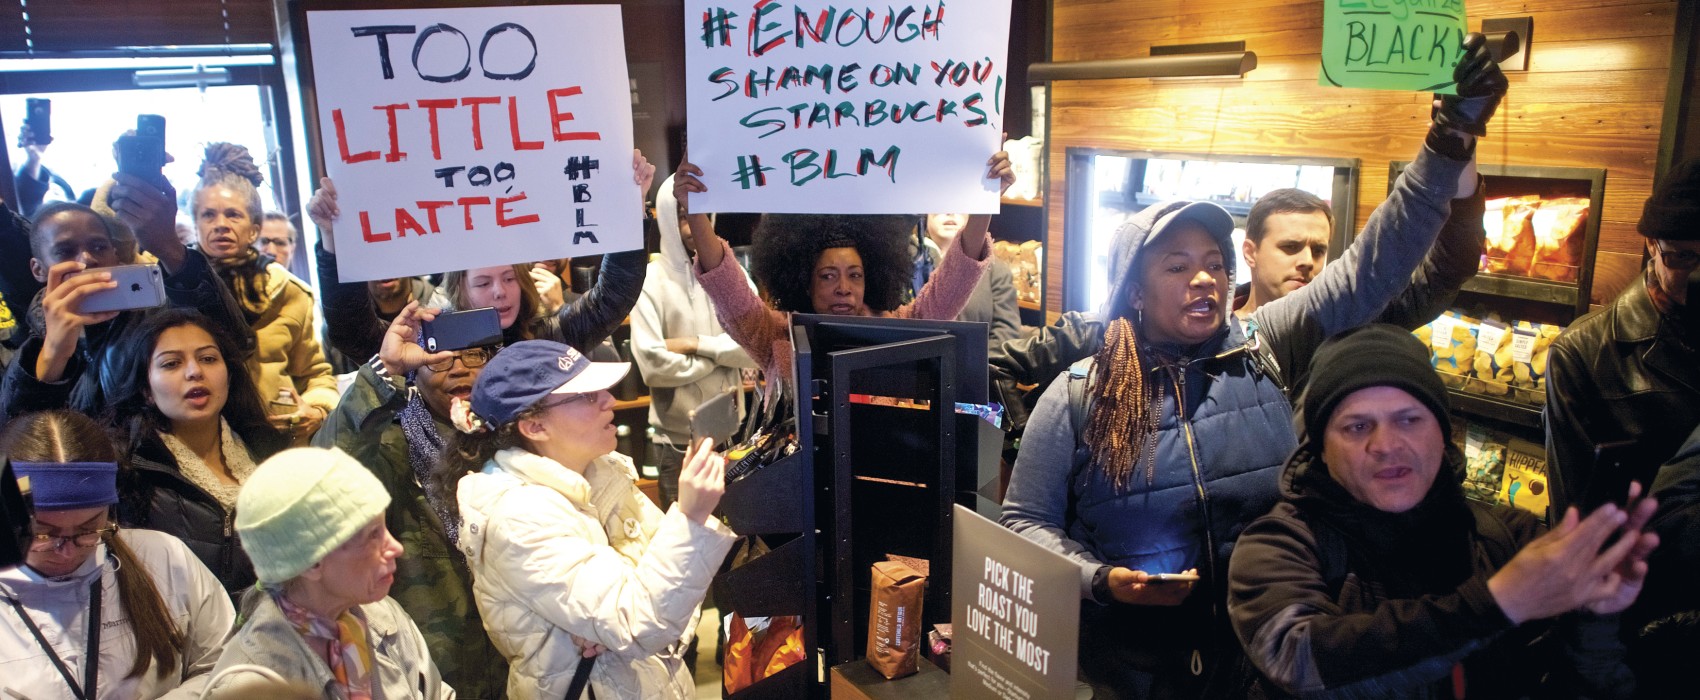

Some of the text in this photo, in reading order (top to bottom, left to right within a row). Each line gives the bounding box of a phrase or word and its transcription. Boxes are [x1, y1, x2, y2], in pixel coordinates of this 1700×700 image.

[350, 22, 538, 83] TOO
[700, 0, 946, 58] #ENOUGH
[1344, 20, 1465, 69] BLACK!
[707, 56, 994, 102] SHAME ON YOU
[332, 86, 601, 164] LITTLE
[435, 161, 516, 187] TOO
[359, 185, 540, 243] LATTÉ
[984, 556, 1035, 605] PICK THE
[102, 617, 128, 629] Marm
[978, 582, 1038, 638] ROAST YOU
[966, 604, 1051, 676] LOVE THE MOST
